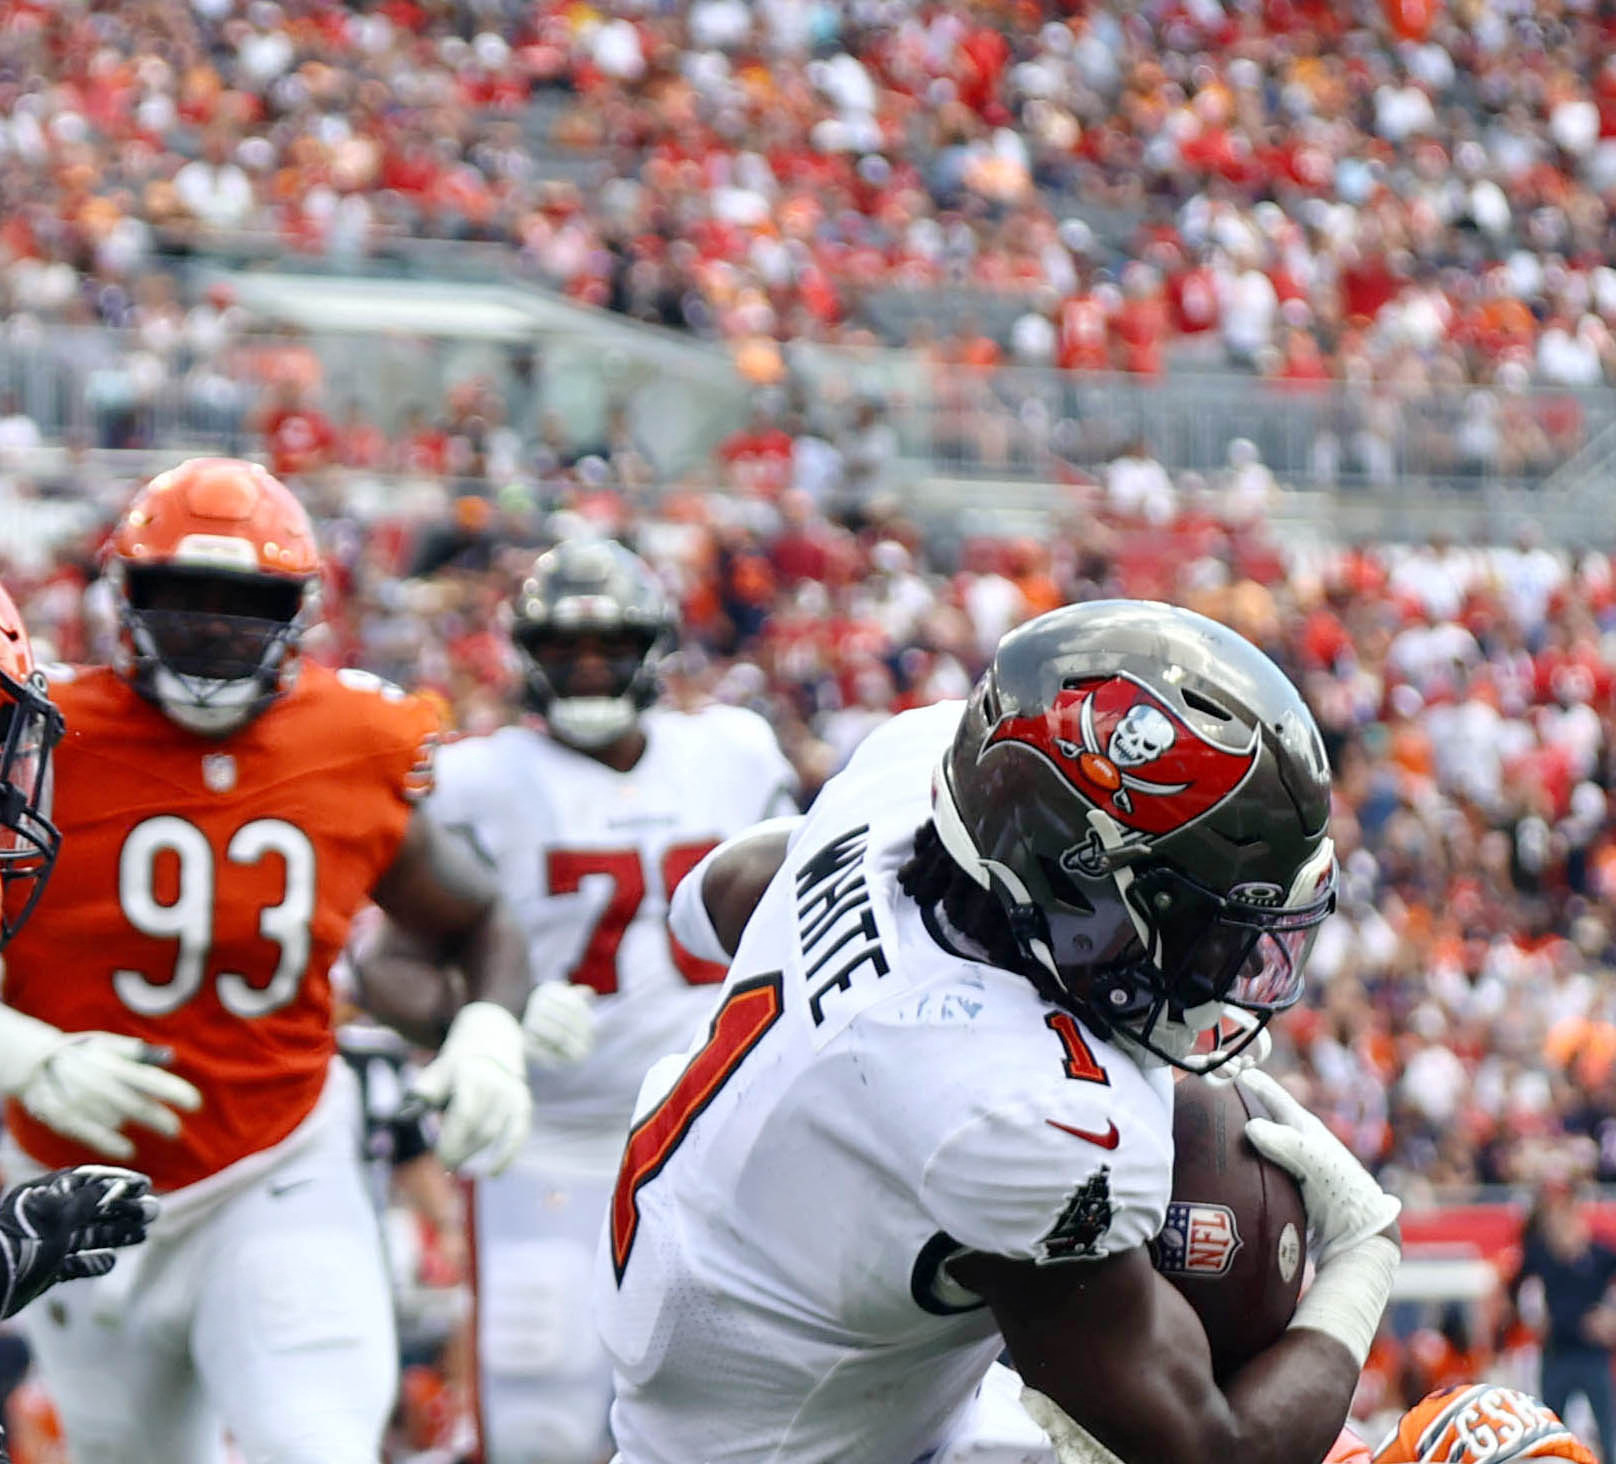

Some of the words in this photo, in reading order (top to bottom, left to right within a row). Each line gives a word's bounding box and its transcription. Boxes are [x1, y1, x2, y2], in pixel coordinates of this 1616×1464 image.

[111, 814, 316, 1018] 93
[795, 823, 891, 1029] WHITE
[610, 968, 785, 1292] 1
[1043, 1009, 1111, 1087] 1
[1187, 1213, 1232, 1269] NFL
